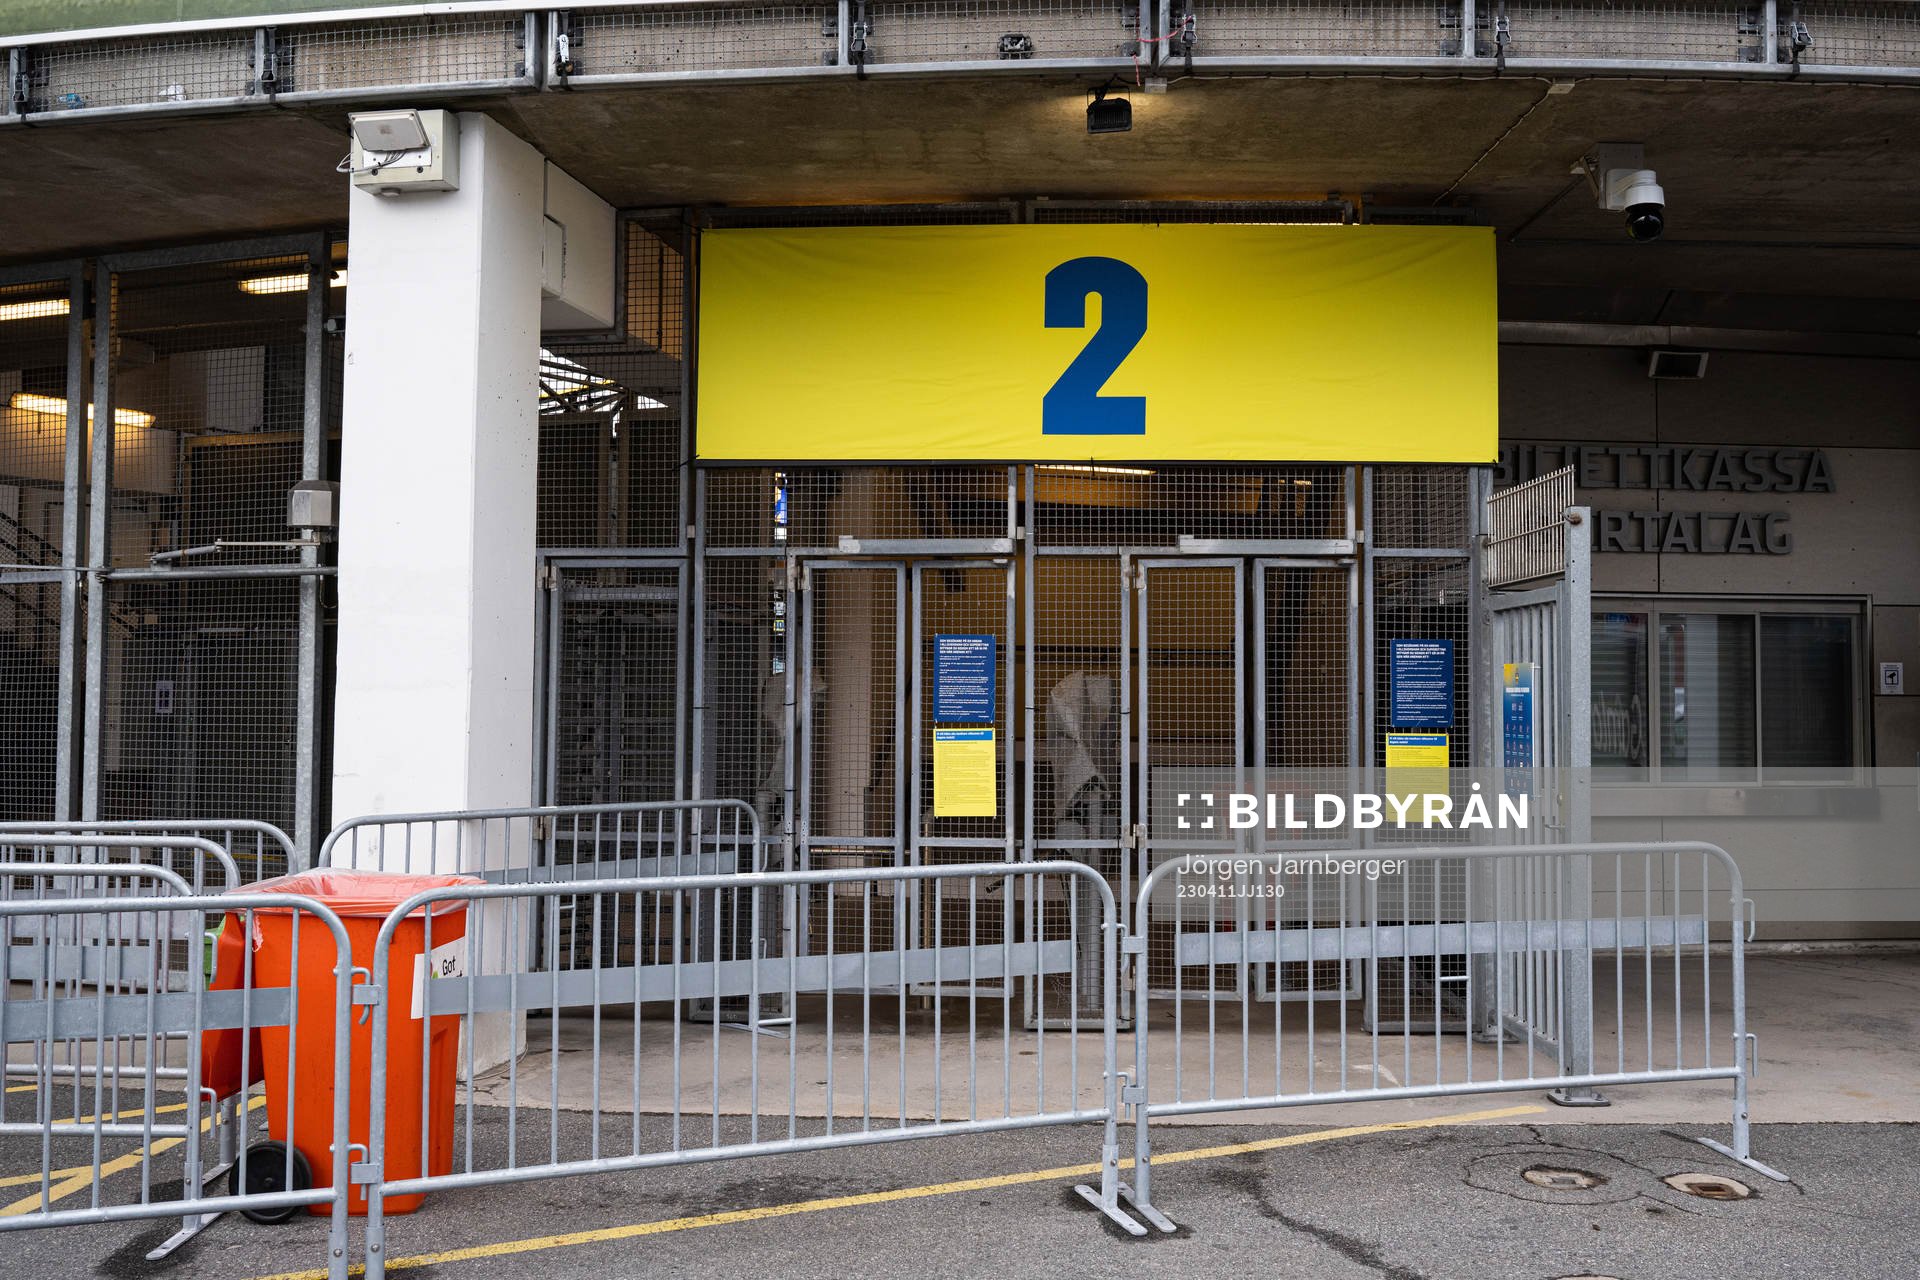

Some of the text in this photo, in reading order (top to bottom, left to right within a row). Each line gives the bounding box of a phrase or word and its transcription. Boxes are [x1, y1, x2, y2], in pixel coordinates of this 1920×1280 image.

[1042, 257, 1149, 436] 2
[1592, 509, 1793, 555] RTALAG
[442, 955, 457, 977] Got
